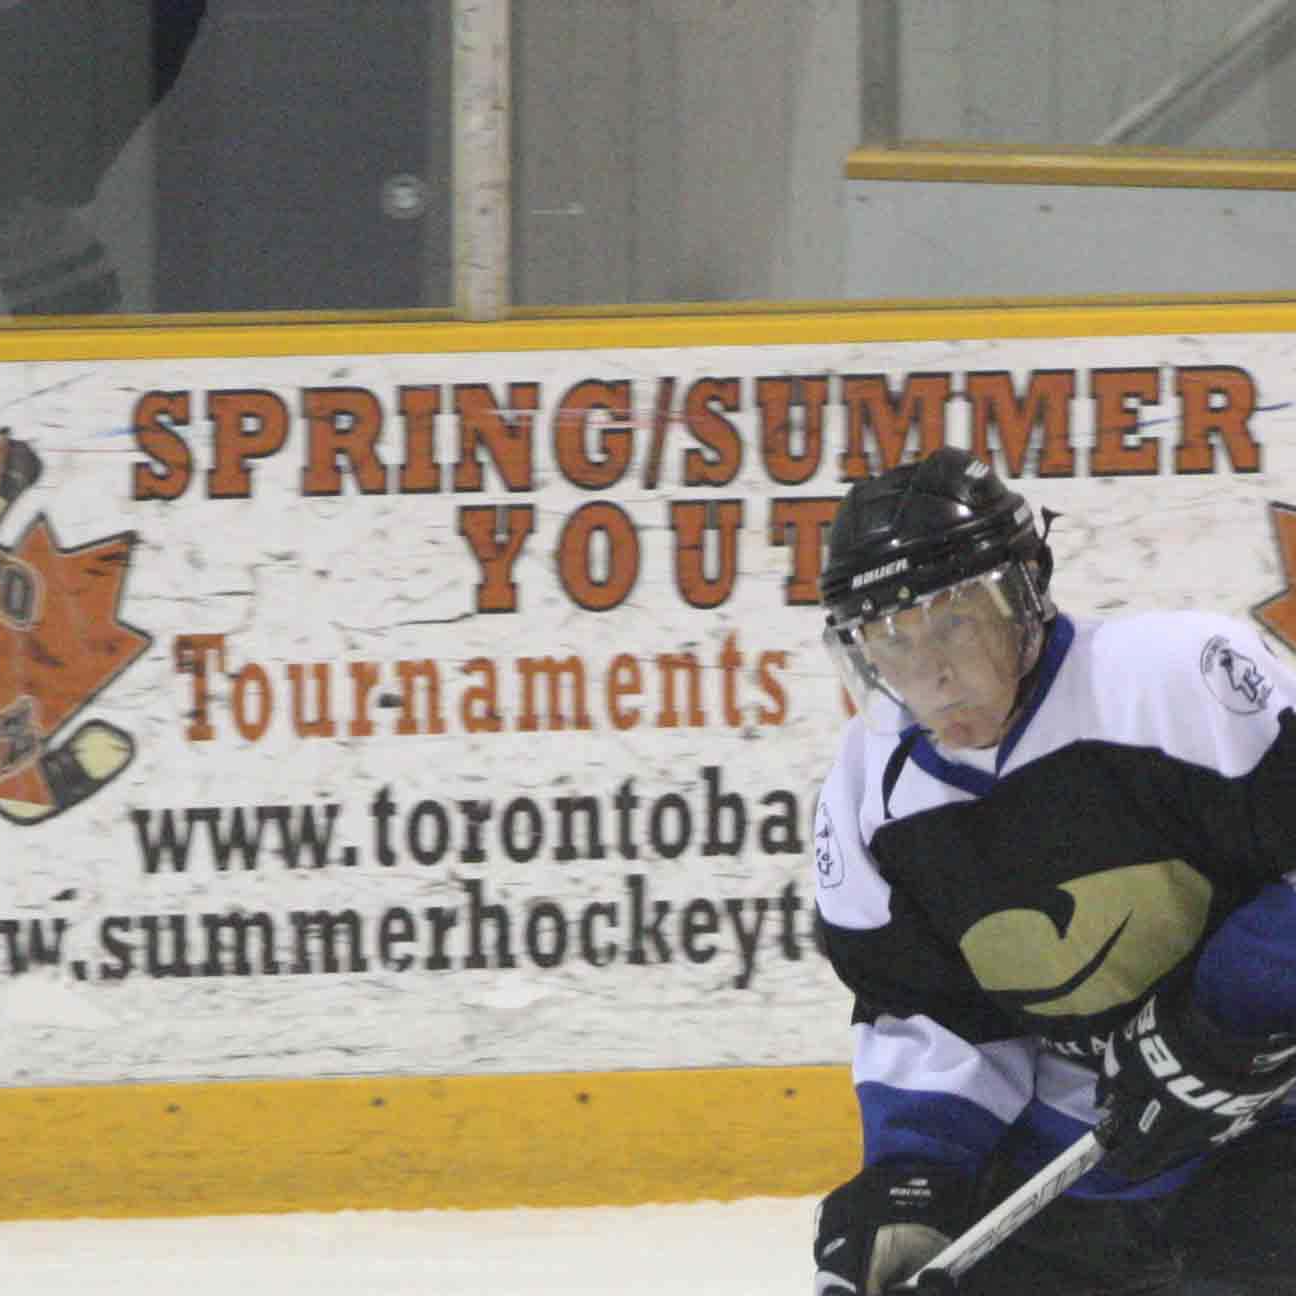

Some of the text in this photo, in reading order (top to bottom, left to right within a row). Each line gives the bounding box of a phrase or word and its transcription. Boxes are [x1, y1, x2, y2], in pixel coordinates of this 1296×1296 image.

[131, 366, 1262, 502] SPRING/SUMMER
[458, 497, 846, 614] YOUT
[174, 627, 789, 742] Tournaments
[129, 767, 804, 875] www.torontoba
